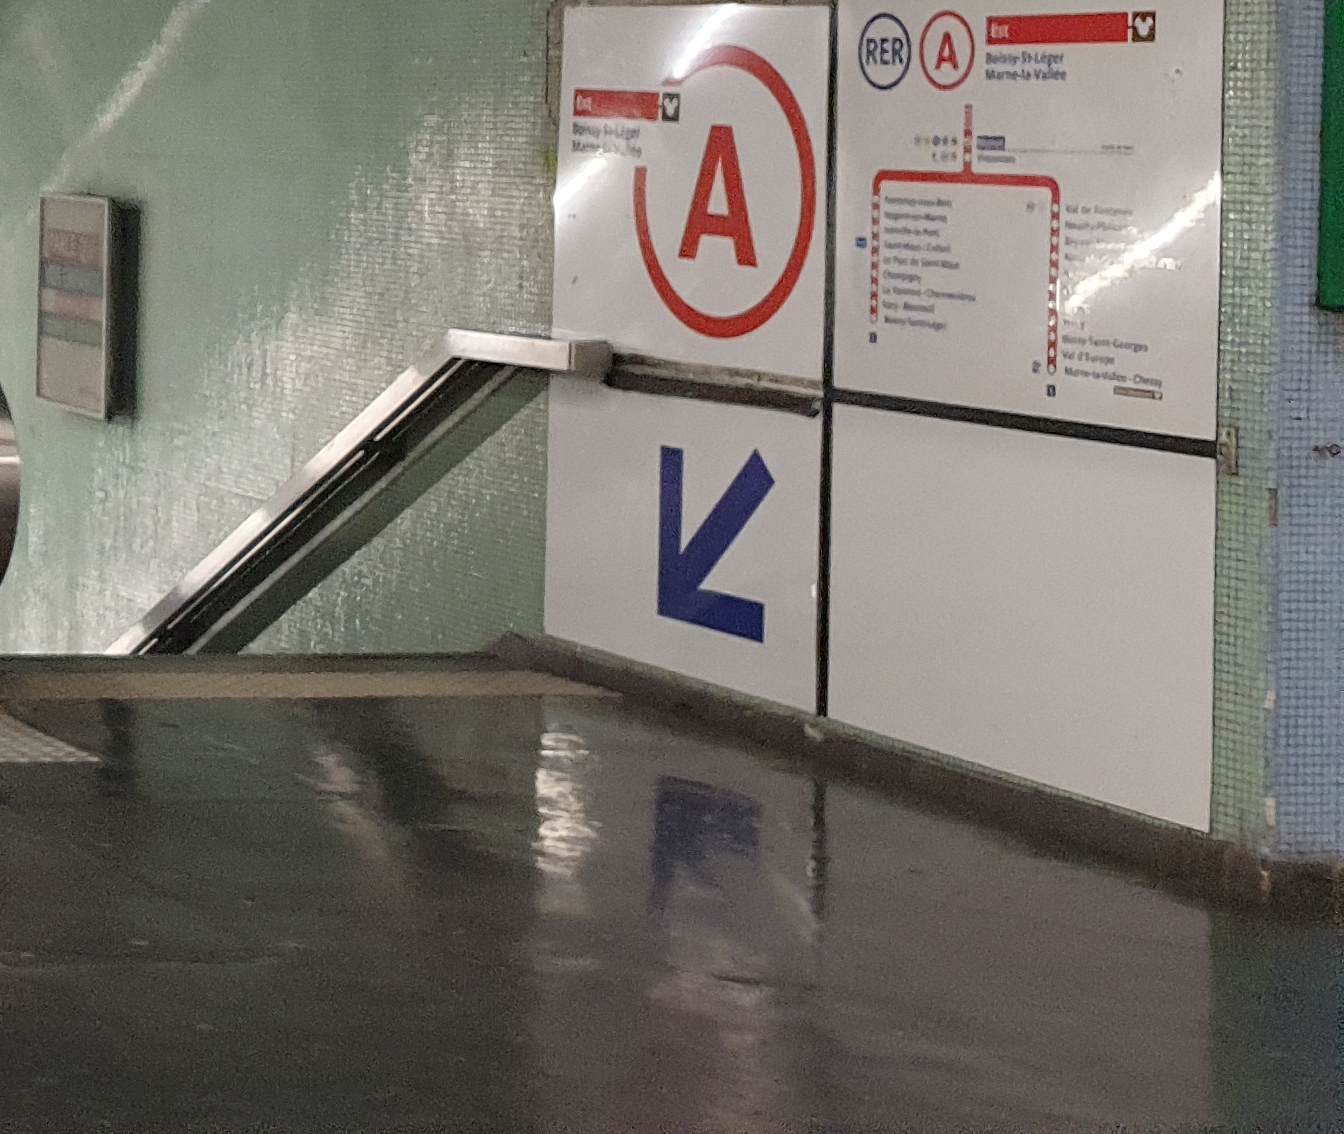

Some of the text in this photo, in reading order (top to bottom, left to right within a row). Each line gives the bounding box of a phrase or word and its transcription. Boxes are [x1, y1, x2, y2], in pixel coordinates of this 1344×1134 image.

[865, 31, 960, 71] RER A
[678, 124, 759, 268] A
